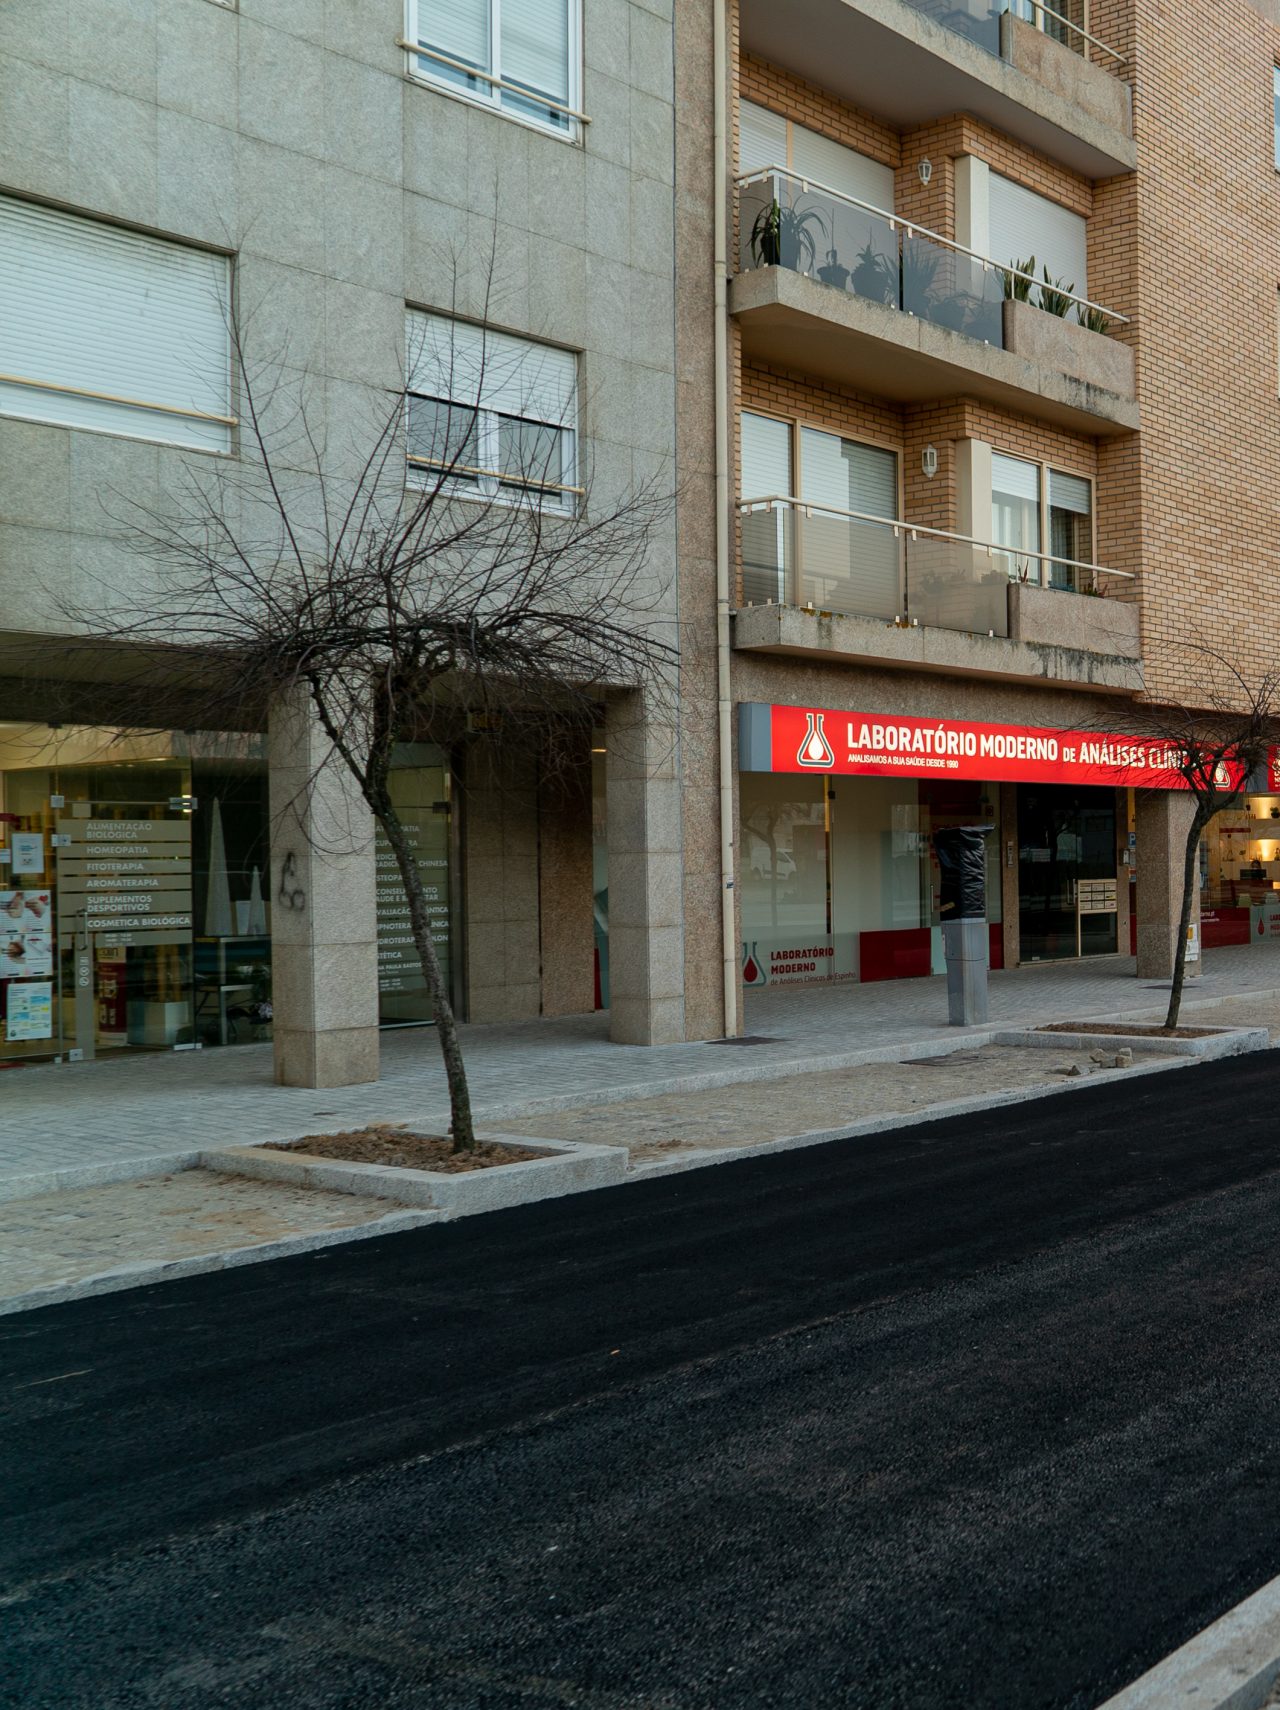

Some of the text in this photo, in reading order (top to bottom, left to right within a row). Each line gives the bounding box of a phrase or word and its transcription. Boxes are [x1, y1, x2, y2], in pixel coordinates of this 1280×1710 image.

[847, 723, 977, 756] LABORATÓRIO
[980, 733, 1058, 761] MODERNO
[1063, 746, 1076, 763] DE
[1079, 738, 1146, 768] ANÁLISES
[848, 754, 887, 765] ANALISAMOS
[926, 758, 946, 768] DESDE
[86, 821, 153, 831] ALIMENTAÇÃO
[86, 846, 149, 854] HOMEOPATIA
[86, 863, 145, 871] FITOTERAPIA
[86, 879, 159, 888] AROMATERAPIA
[87, 895, 153, 904] SUPLEMENTOS
[87, 903, 150, 912] DESPORTIVOS
[141, 916, 191, 926] BIOLÓGICA
[770, 945, 834, 961] LABORATÓRIO
[771, 962, 816, 975] MODERNO
